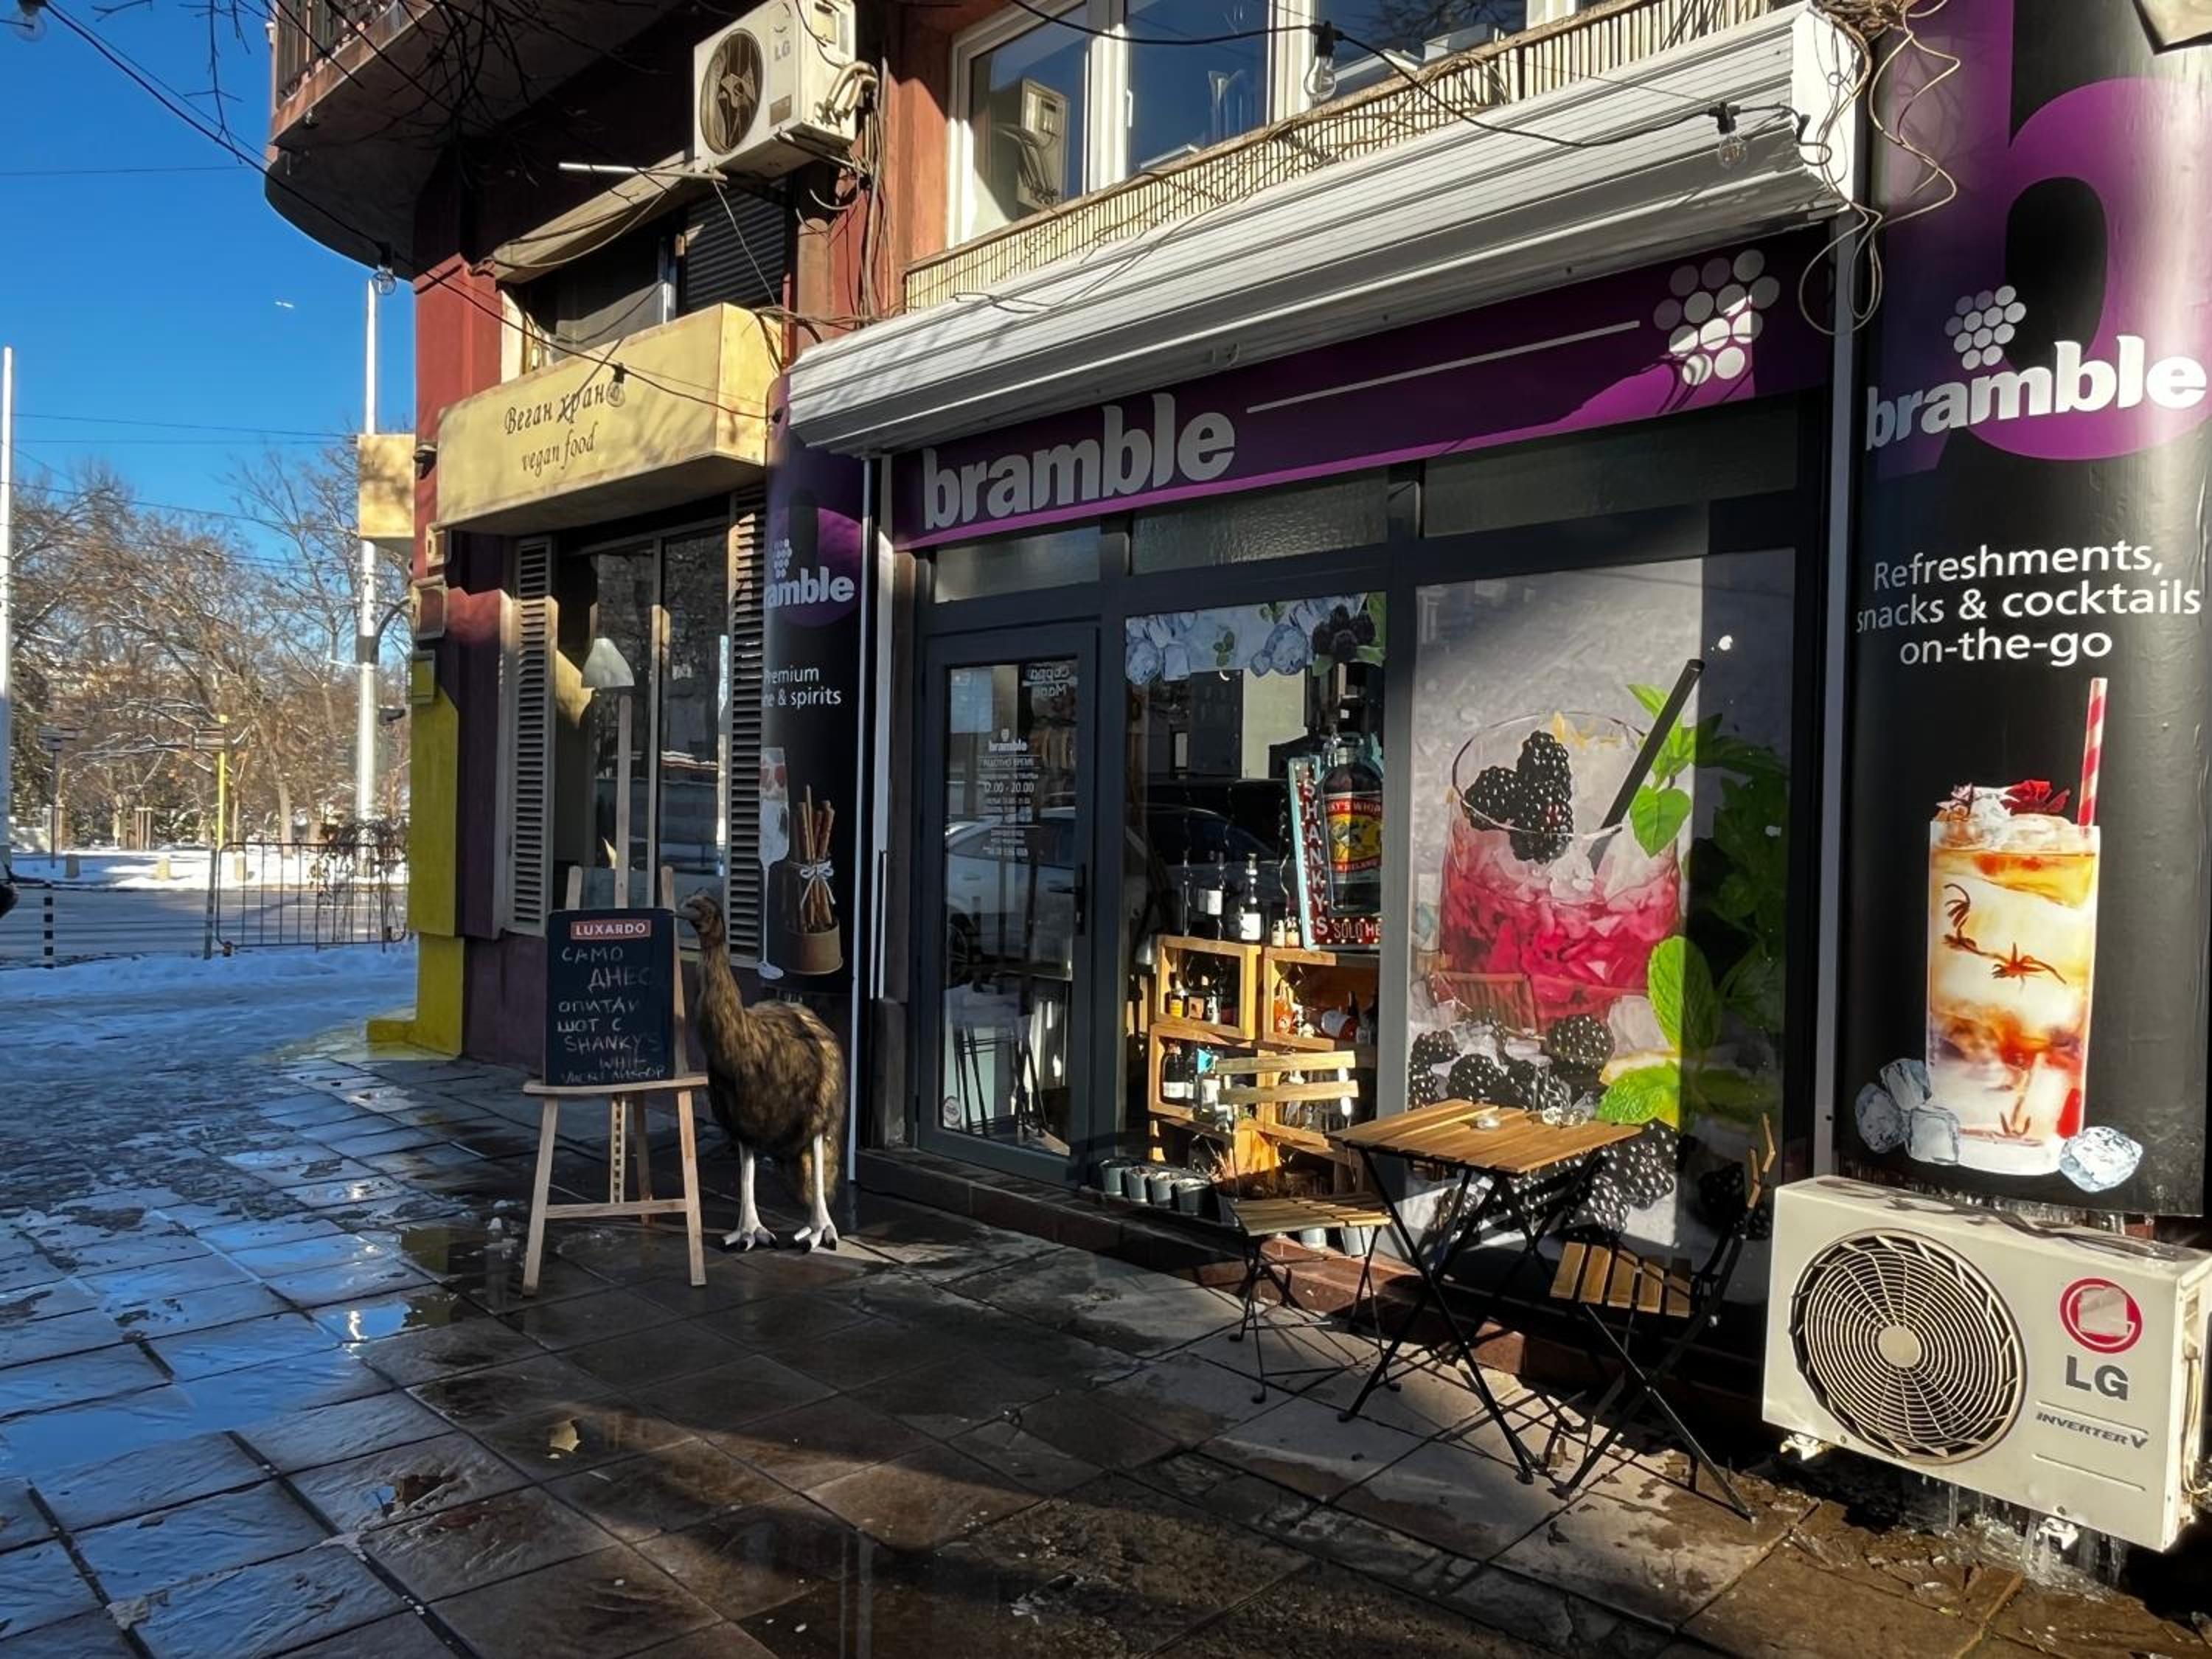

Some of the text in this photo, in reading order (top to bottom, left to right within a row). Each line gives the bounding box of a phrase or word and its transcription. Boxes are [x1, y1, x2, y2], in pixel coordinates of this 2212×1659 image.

[775, 40, 790, 60] LG
[1865, 335, 2207, 451] bramble
[504, 402, 552, 434] Веган
[522, 421, 599, 478] vegan food
[922, 392, 1236, 531] bramble
[1874, 538, 2163, 591] Refreshments,
[765, 566, 855, 608] amble
[1856, 579, 2201, 633] snacks & cocktails
[1899, 627, 2112, 667] on-the-go
[790, 686, 841, 709] spirits
[575, 922, 646, 936] LUXARDO
[1365, 922, 1381, 938] HE
[562, 946, 623, 964] САМО
[557, 1018, 599, 1033] ШОТ
[2065, 1354, 2128, 1401] LG
[2036, 1411, 2128, 1445] INVERTER
